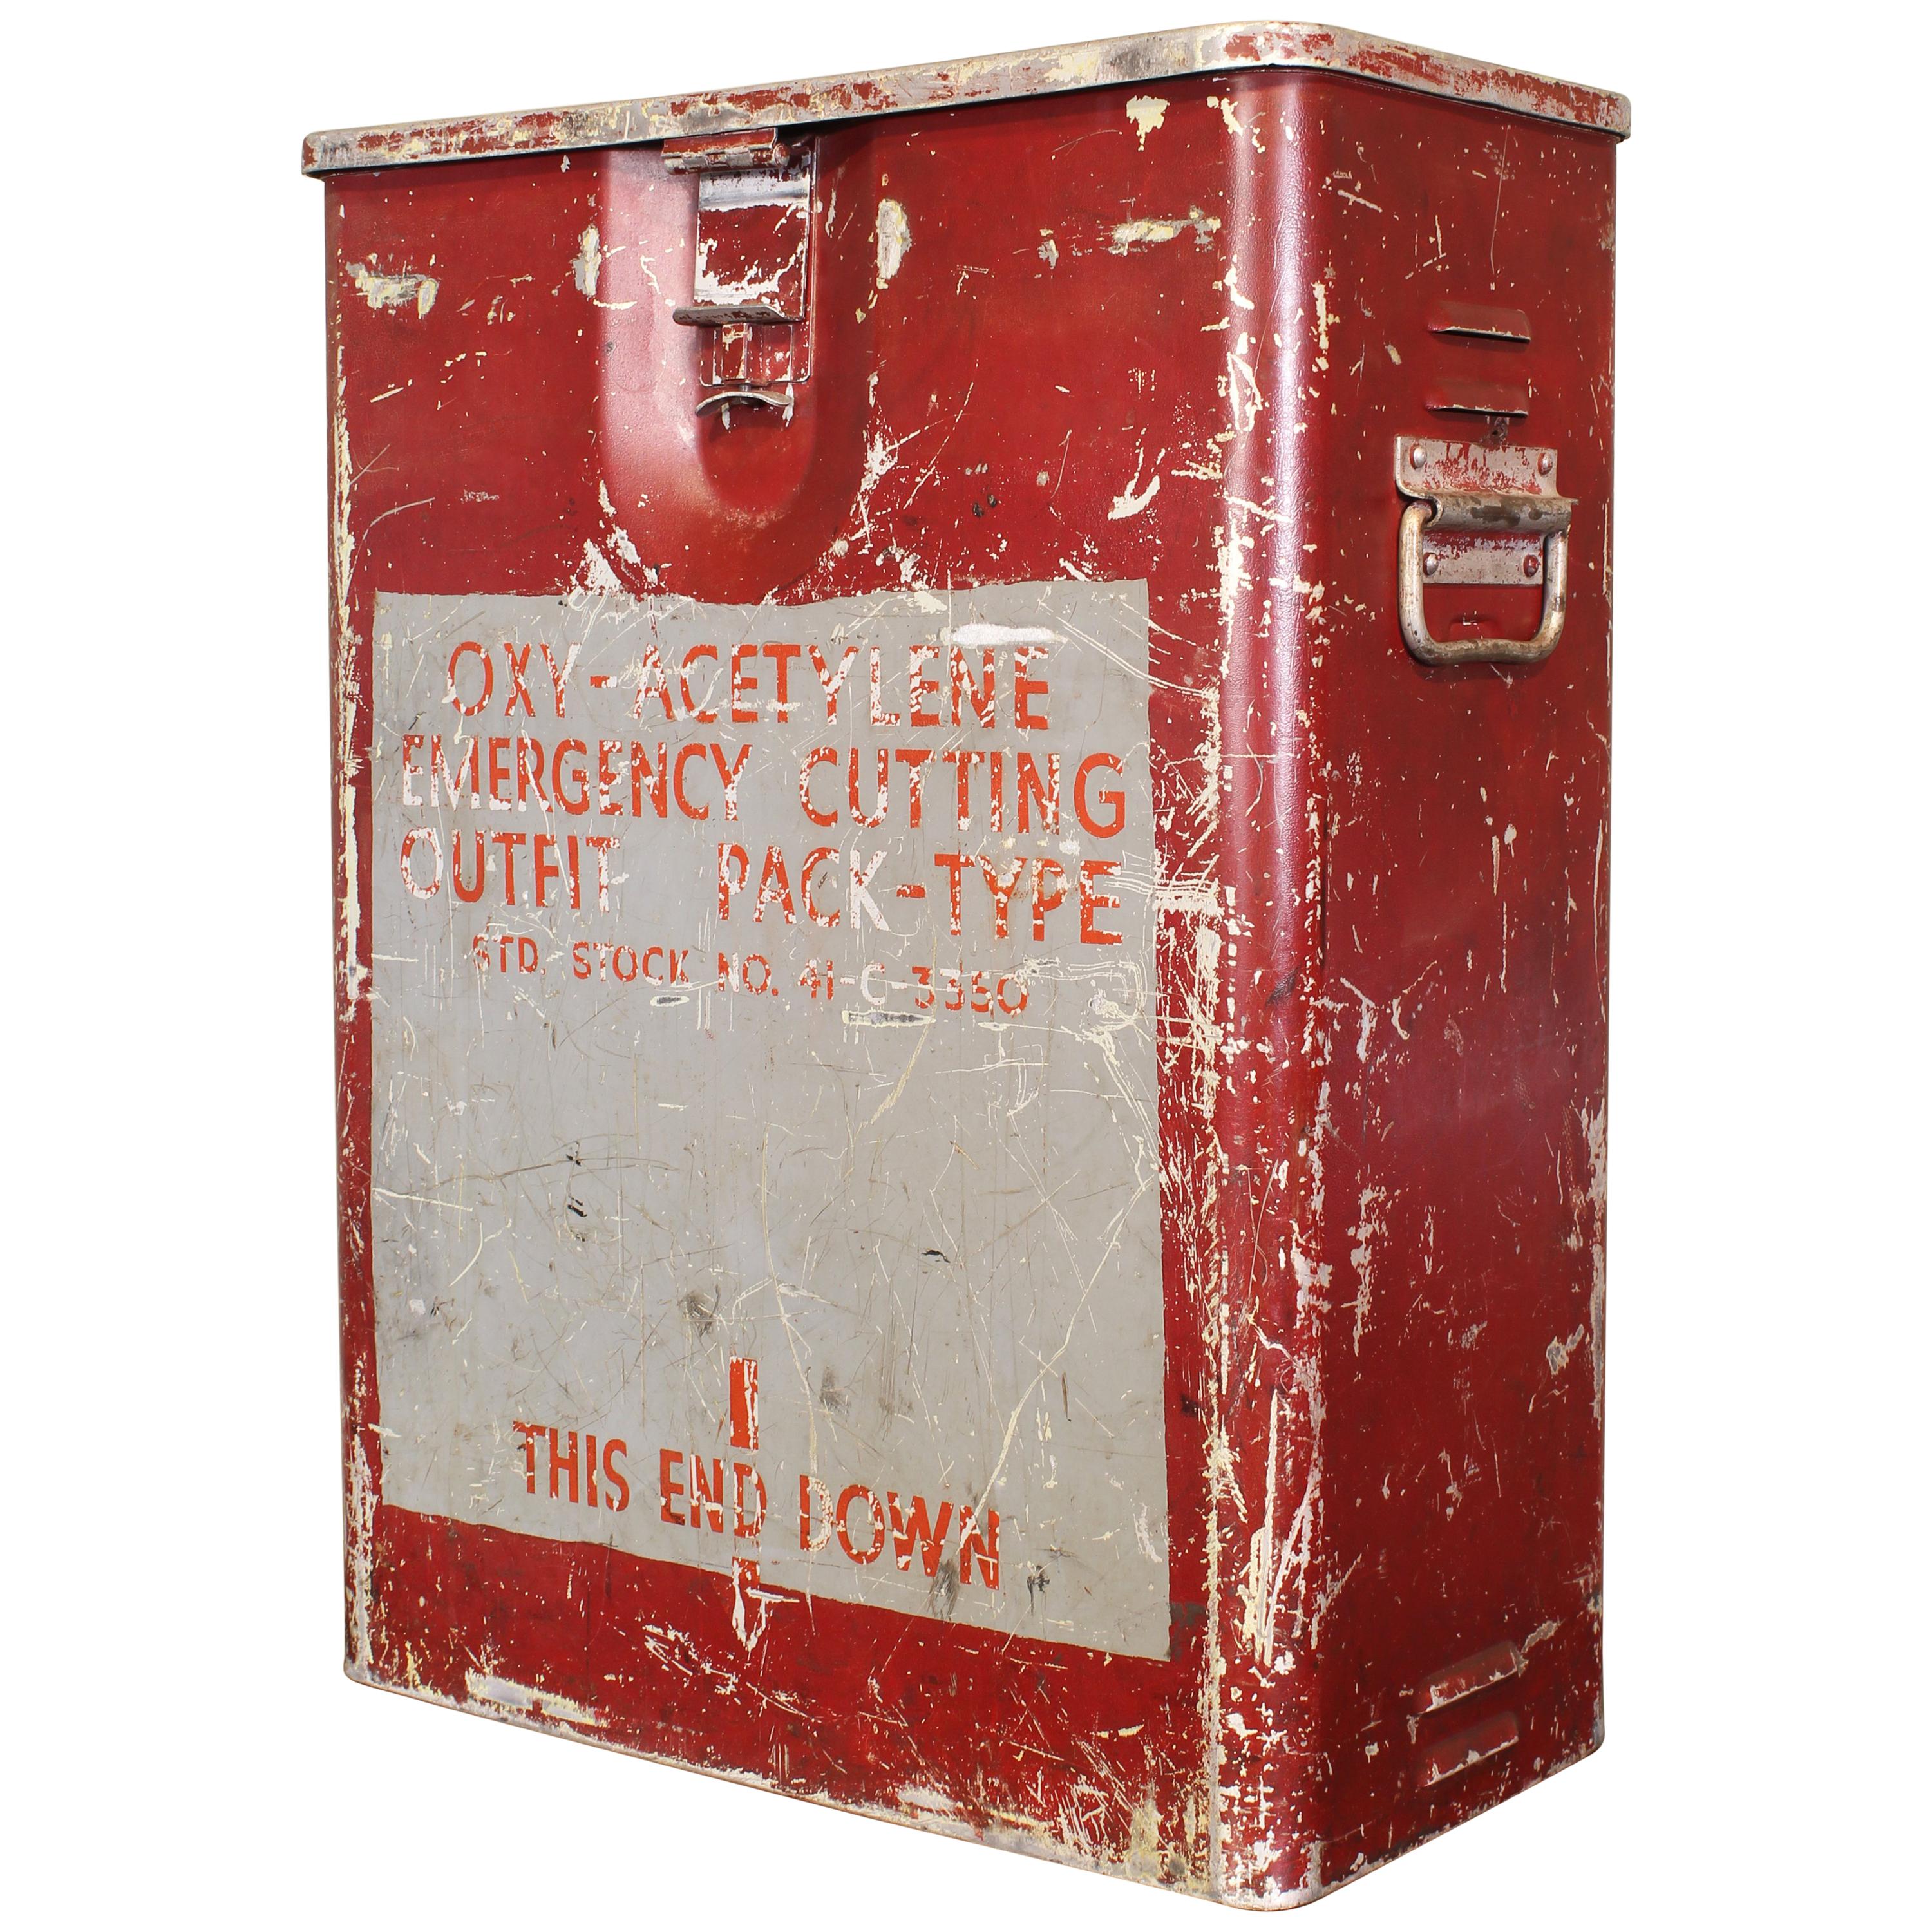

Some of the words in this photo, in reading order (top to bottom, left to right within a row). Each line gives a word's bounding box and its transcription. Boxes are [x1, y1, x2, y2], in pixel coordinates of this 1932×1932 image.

[447, 641, 1050, 730] OXY-ACETYLENE
[401, 734, 753, 822] EMERGENCY
[799, 747, 1126, 838] CUTTING
[400, 826, 621, 913] OUTFIT
[717, 841, 1124, 945] PACK-TYPE
[572, 940, 690, 987] STOCK
[718, 952, 779, 996] NO.
[513, 1421, 630, 1512] THIS
[659, 1448, 767, 1539] END
[799, 1474, 1001, 1591] DOWN
